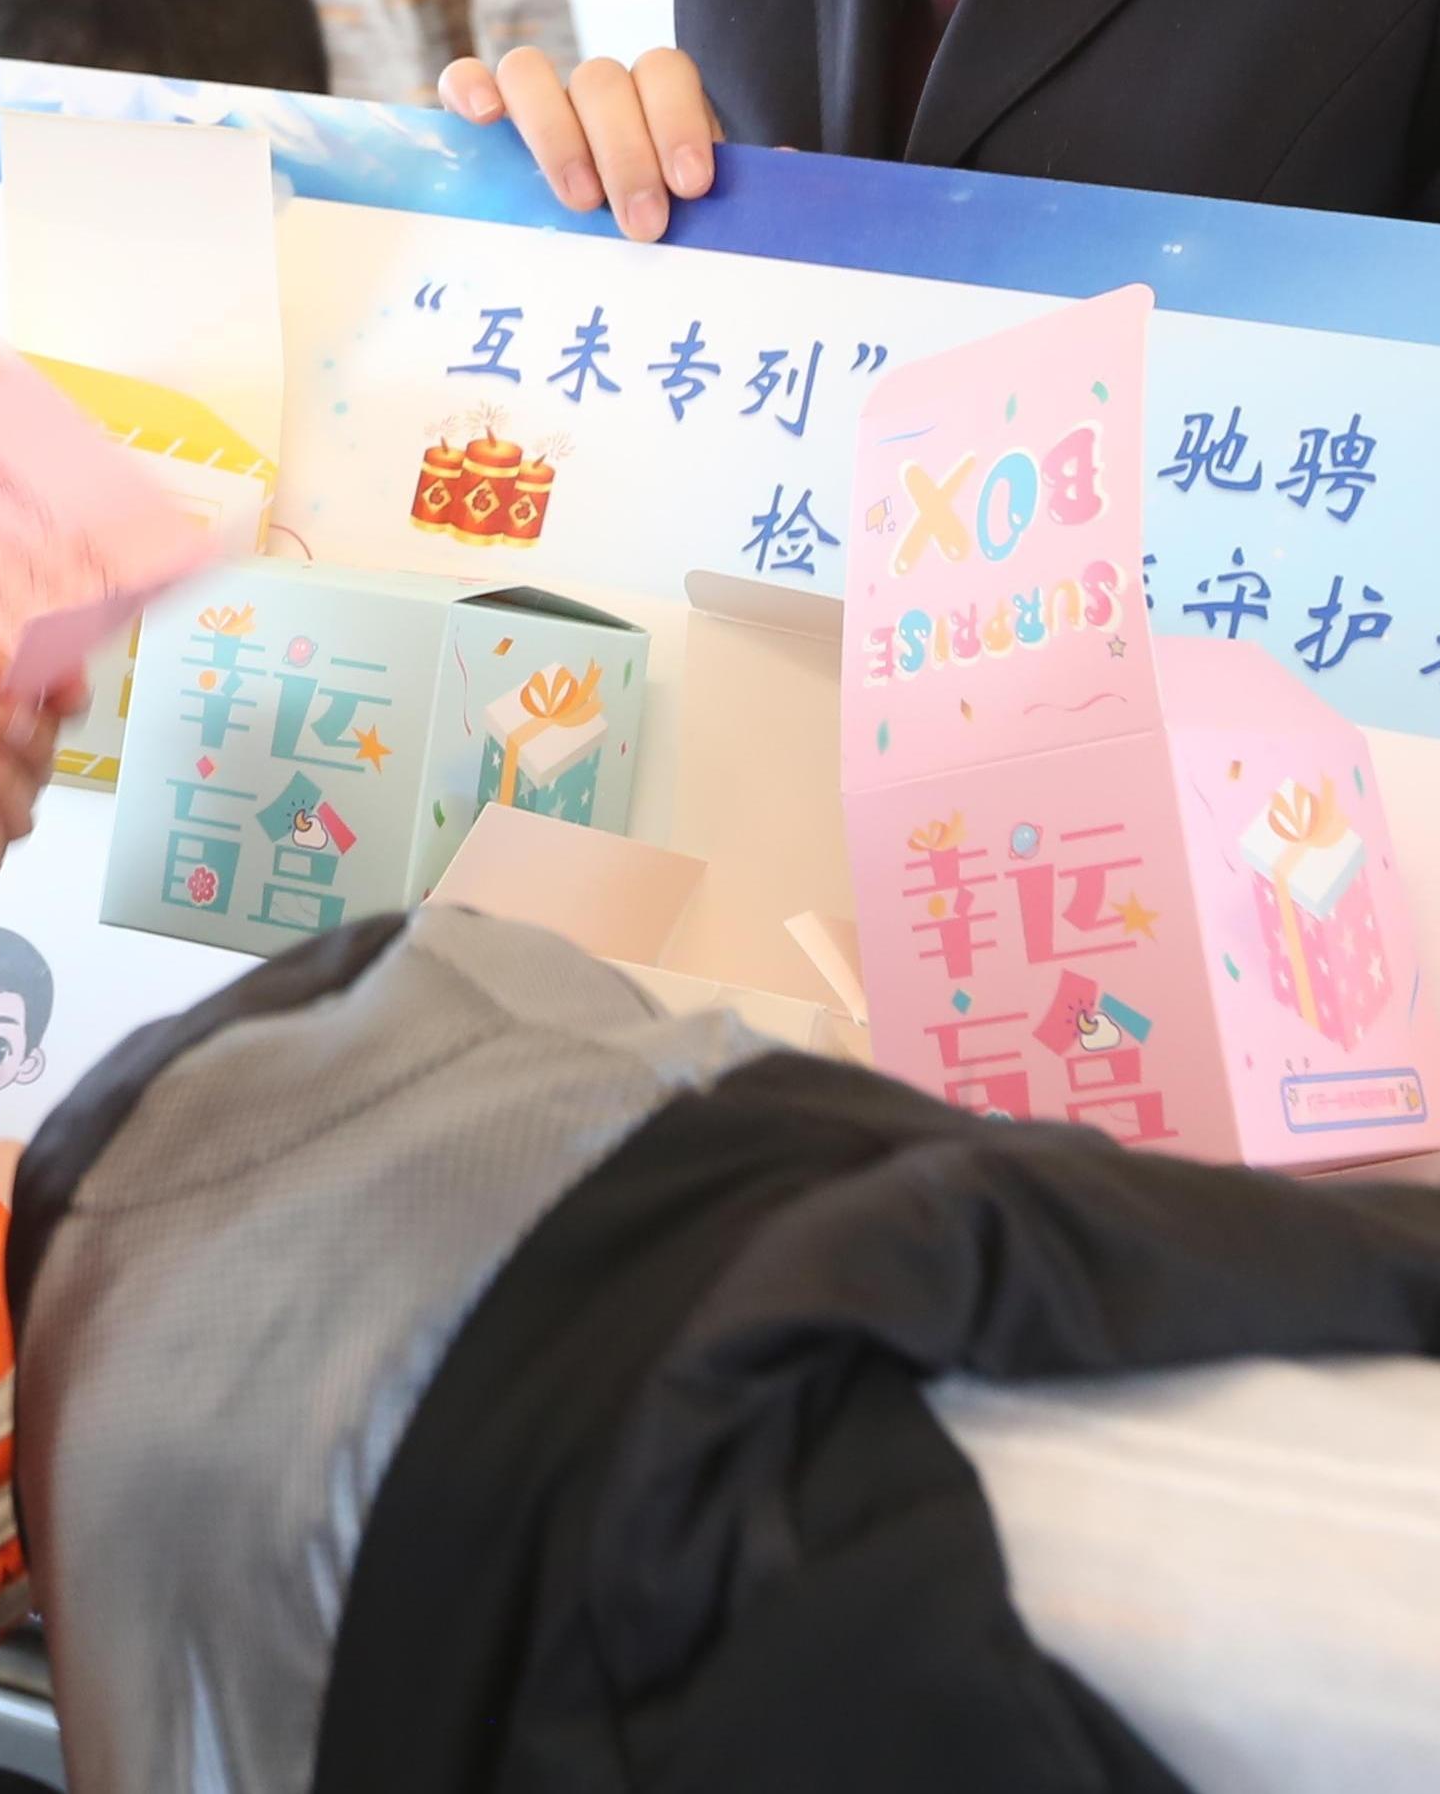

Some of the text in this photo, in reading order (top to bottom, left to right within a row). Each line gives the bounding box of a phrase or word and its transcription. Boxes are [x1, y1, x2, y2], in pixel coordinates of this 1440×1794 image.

[891, 420, 1110, 578] BOX
[180, 602, 393, 774] 幸运
[863, 558, 1127, 688] SURPRISE
[902, 811, 1160, 980] 幸运
